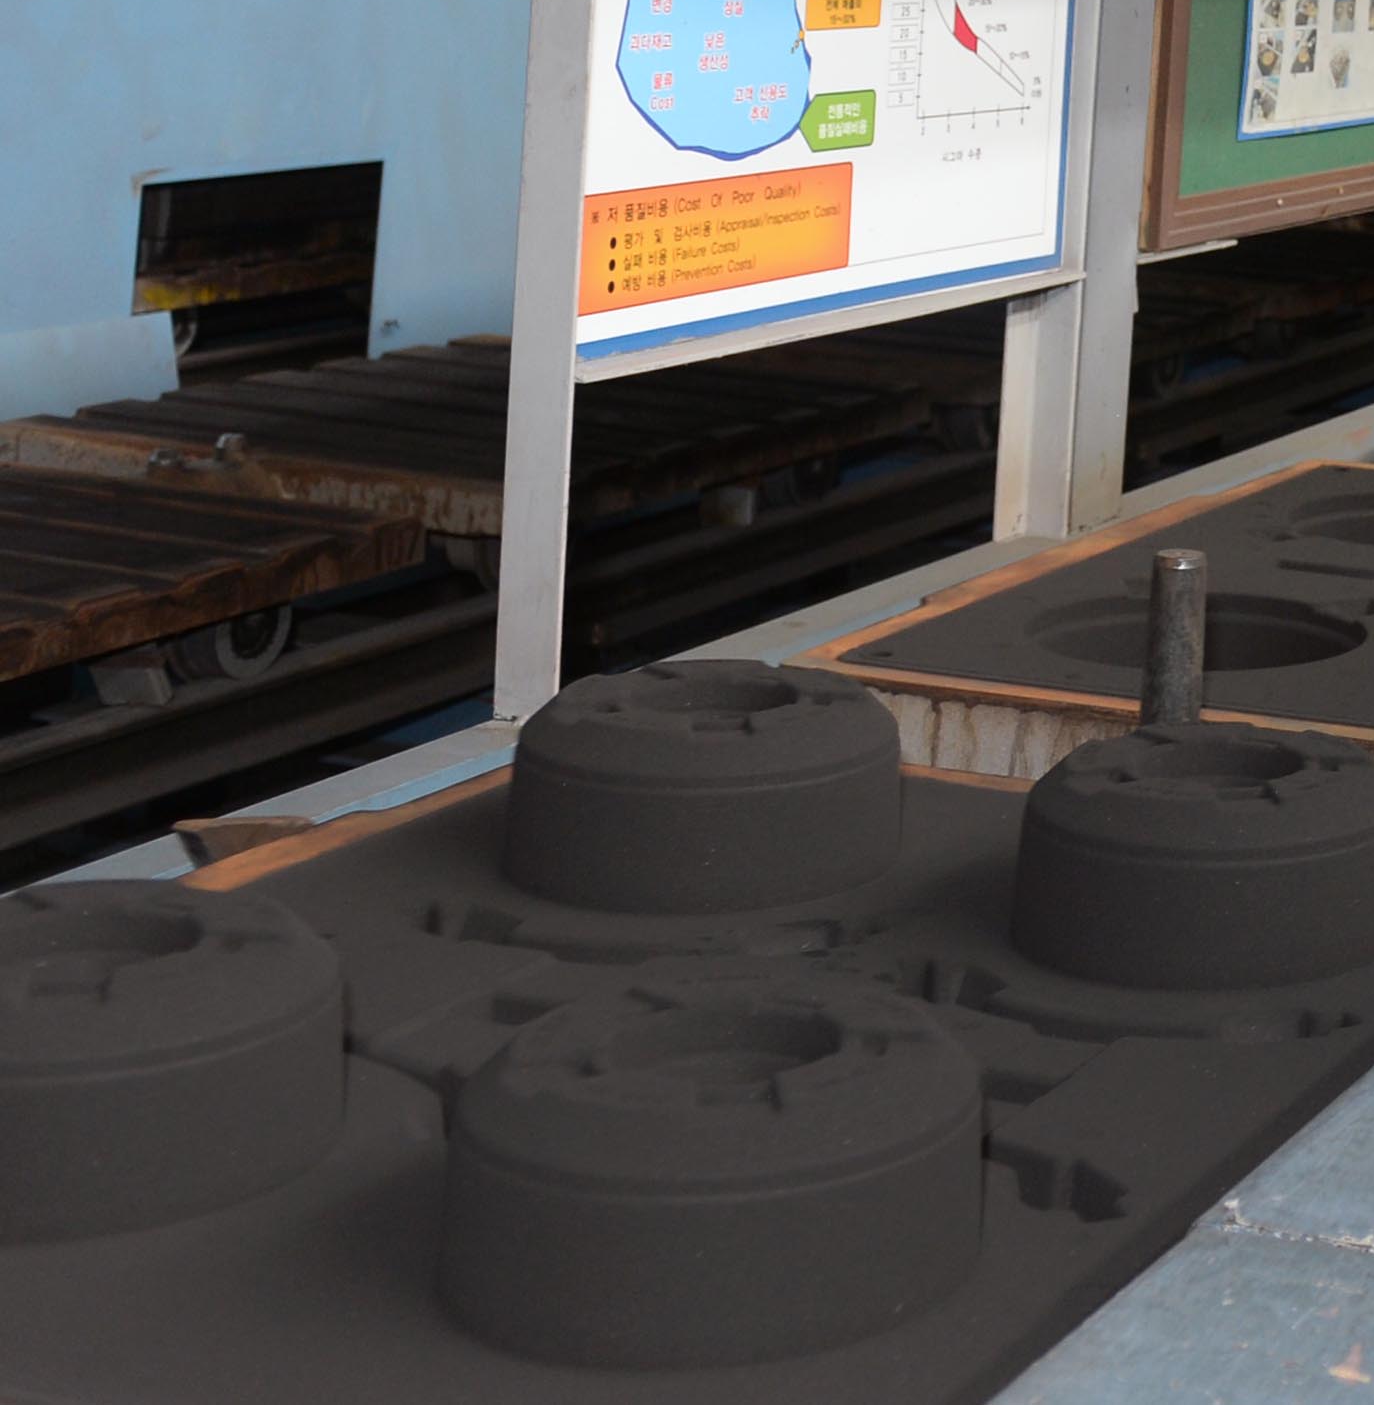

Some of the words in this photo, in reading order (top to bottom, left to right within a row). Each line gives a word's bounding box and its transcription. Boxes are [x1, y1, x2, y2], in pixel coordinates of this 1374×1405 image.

[725, 0, 743, 16] 상실
[631, 34, 672, 50] 과다재고
[699, 55, 729, 71] 생산성
[654, 73, 673, 90] 물류
[734, 87, 753, 102] 고객
[760, 85, 787, 102] 신용도
[651, 97, 674, 110] Cost
[828, 103, 861, 120] 전통적인
[818, 119, 867, 139] 품질실패비용
[624, 198, 668, 223] 품질비용
[673, 197, 701, 216] (Cost
[710, 193, 723, 208] Of
[731, 190, 754, 205] Poor
[765, 182, 802, 201] Quality)
[624, 232, 644, 250] 평가
[654, 228, 663, 245] 및
[674, 220, 712, 243] 검사비용
[813, 201, 841, 219] Costs)
[623, 253, 643, 271] 실패
[648, 249, 668, 266] 비용
[672, 244, 707, 263] (Failure
[711, 238, 741, 255] Costs)
[622, 273, 641, 292] 예방
[647, 270, 666, 287] 비용
[670, 261, 724, 283] (Prevention
[727, 255, 757, 274] Costs)
